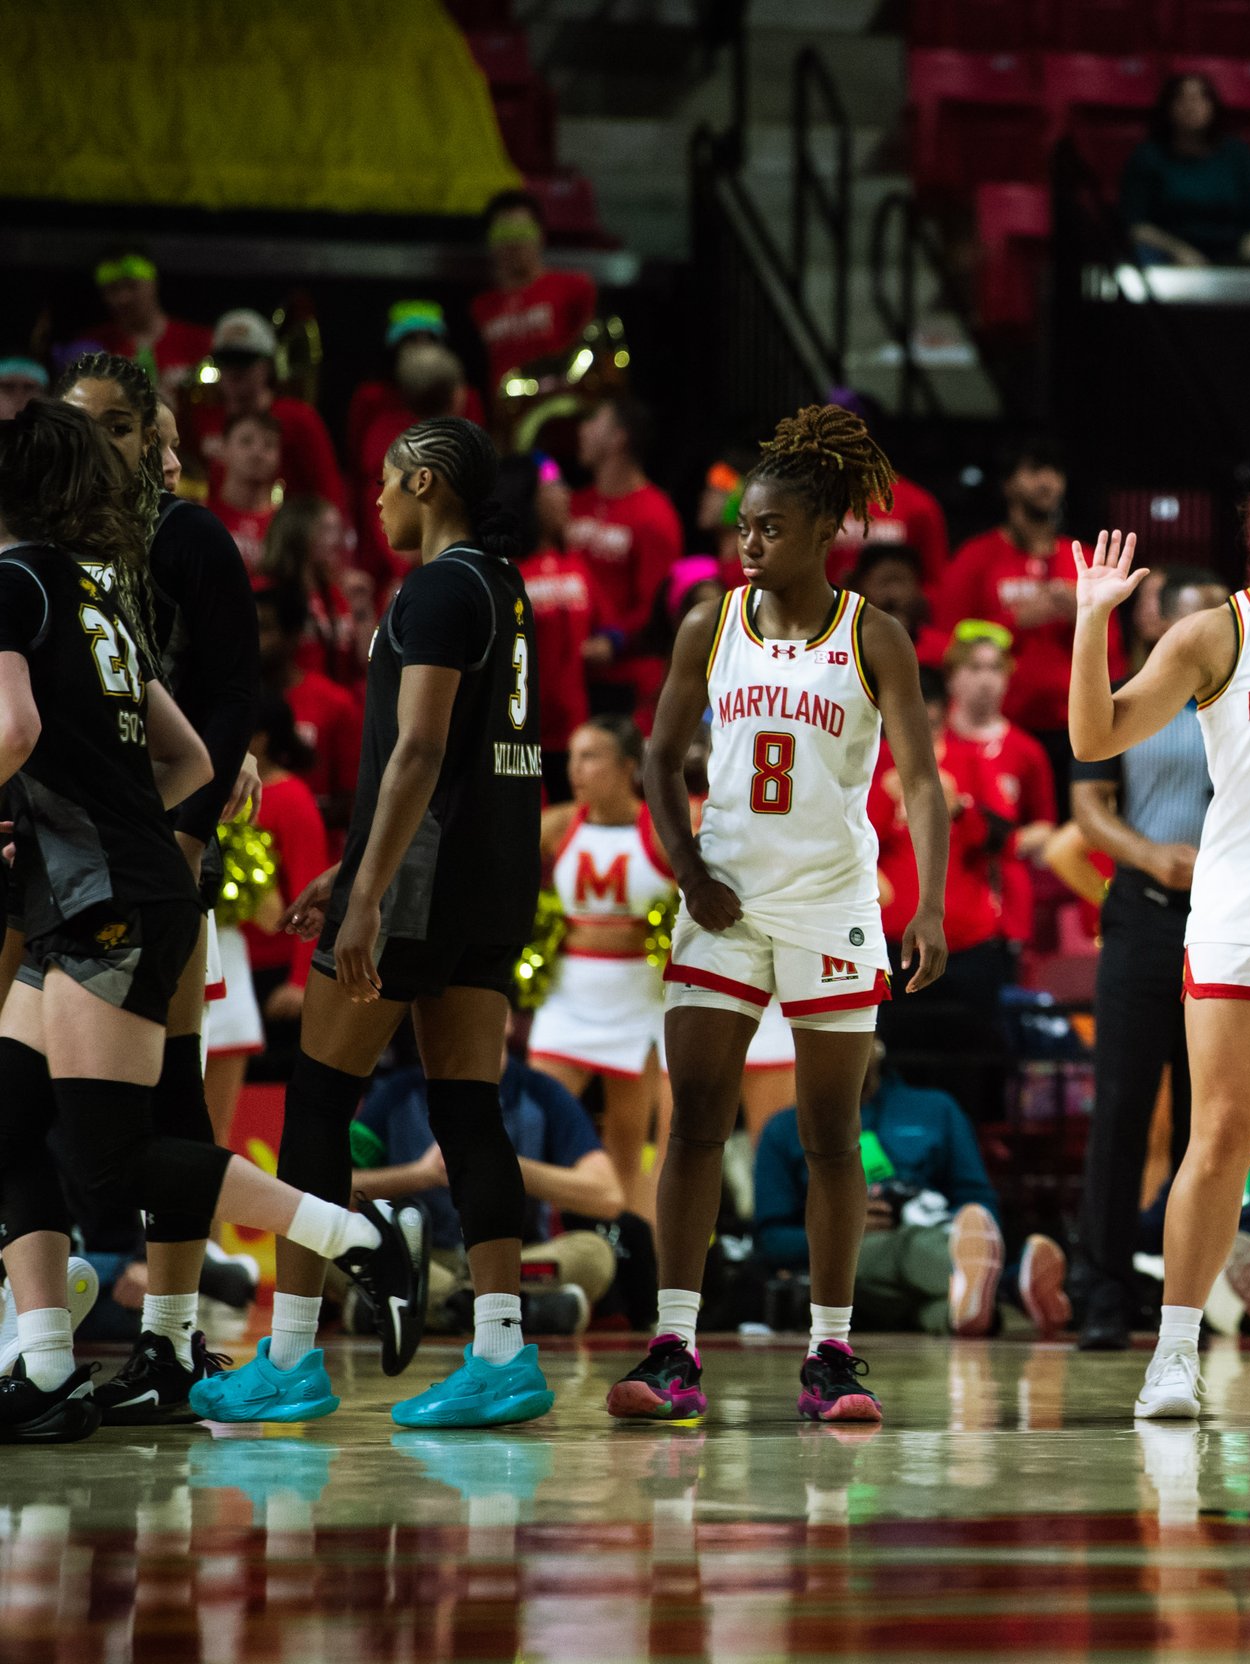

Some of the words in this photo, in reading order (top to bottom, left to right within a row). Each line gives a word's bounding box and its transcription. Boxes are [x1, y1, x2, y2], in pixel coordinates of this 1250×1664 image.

[79, 603, 145, 706] 21
[508, 633, 528, 730] 3
[718, 685, 846, 738] MARYLAND
[750, 730, 796, 815] 8
[574, 851, 631, 906] M
